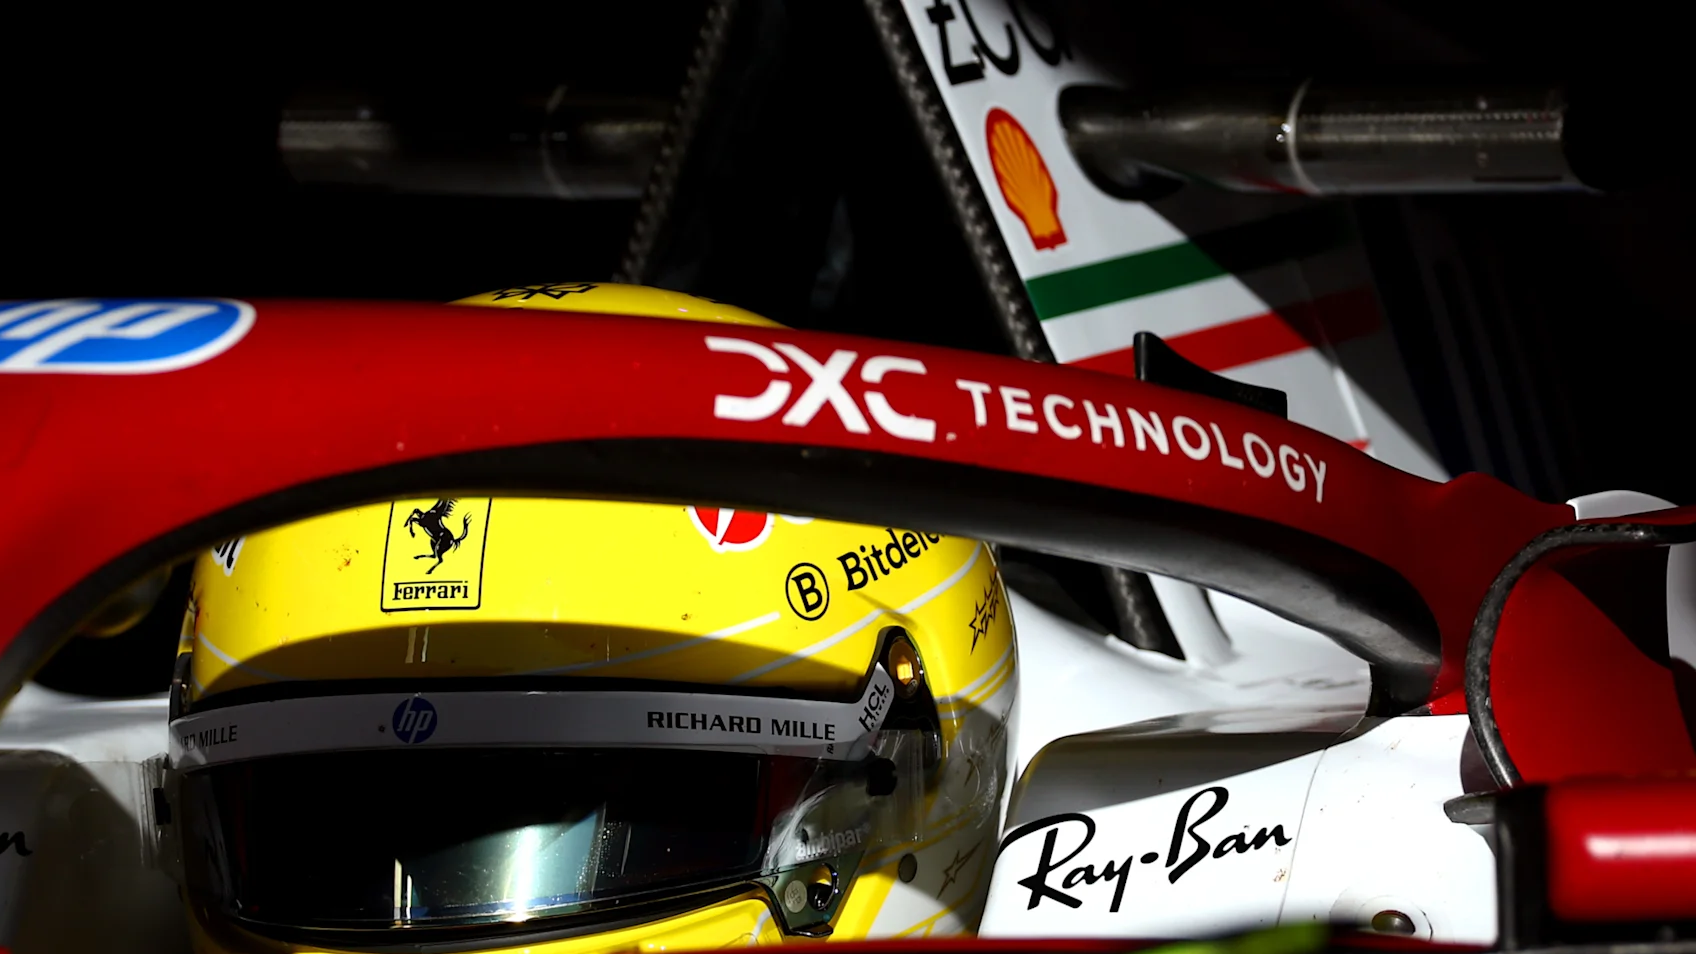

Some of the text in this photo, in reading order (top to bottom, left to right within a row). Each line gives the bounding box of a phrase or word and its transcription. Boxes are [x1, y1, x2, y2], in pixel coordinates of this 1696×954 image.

[704, 335, 1327, 503] DXC TECHNOLOGY
[392, 580, 469, 600] Ferrari
[396, 697, 433, 744] hp
[647, 711, 835, 741] RICHARD MILLE
[200, 725, 237, 747] MILLE
